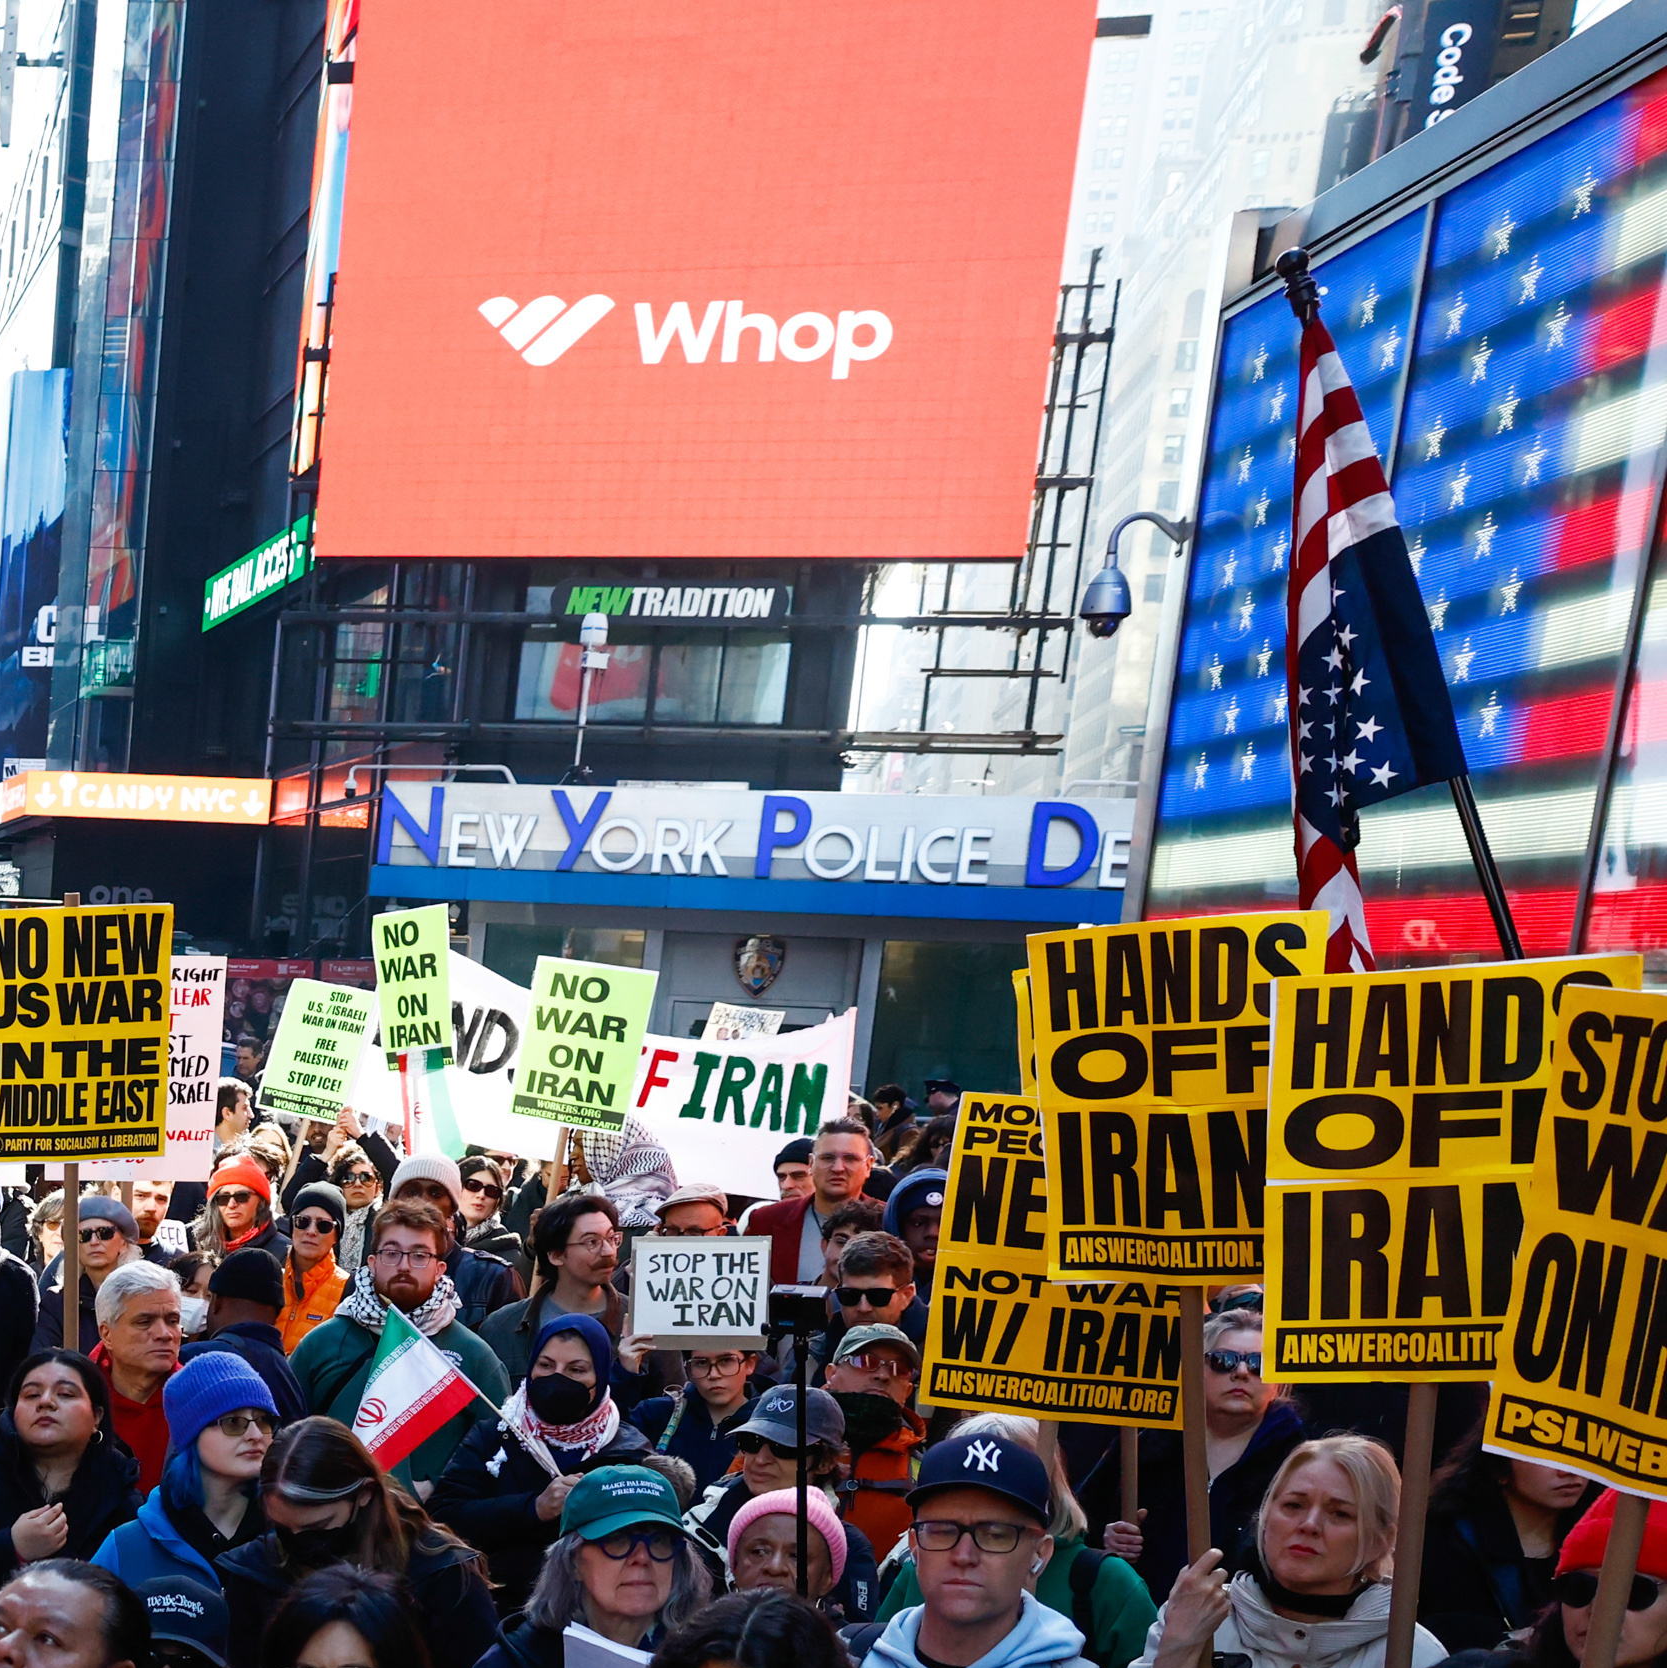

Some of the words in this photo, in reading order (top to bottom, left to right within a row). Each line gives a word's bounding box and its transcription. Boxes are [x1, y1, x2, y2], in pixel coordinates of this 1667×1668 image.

[1432, 21, 1472, 105] Code
[634, 300, 893, 379] Whop
[180, 786, 236, 812] NYC
[377, 784, 538, 869] NEW
[551, 788, 728, 877] YORK
[754, 795, 993, 885] POLICE
[383, 920, 419, 948] NO
[329, 991, 353, 1004] STOP
[397, 993, 428, 1019] ON
[302, 1013, 324, 1026] WAR
[325, 1018, 337, 1029] ON
[338, 1020, 365, 1035] IRAN!
[315, 1038, 338, 1051] FREE
[293, 1050, 349, 1071] PALESTINE!
[287, 1071, 317, 1087] STOP
[317, 1076, 342, 1093] ICE!
[680, 1051, 828, 1136] IRAN
[264, 1087, 302, 1102] WORKERS
[303, 1096, 330, 1107] WORLD
[514, 1106, 556, 1124] WORKERS
[556, 1112, 591, 1128] WORLD
[592, 1117, 622, 1132] PARTY
[4, 1135, 34, 1152] PARTY
[35, 1135, 53, 1151] FOR
[54, 1134, 99, 1150] SOCIALISM
[100, 1134, 108, 1149] &
[109, 1132, 158, 1149] LIBERATION
[648, 1253, 706, 1277] STOP
[712, 1251, 760, 1275] THE
[647, 1278, 704, 1302] WAR
[711, 1276, 758, 1301] ON
[673, 1303, 756, 1327] IRAN
[602, 1481, 625, 1491] MAKE
[612, 1487, 635, 1496] FREE
[636, 1487, 661, 1496] AGAIN
